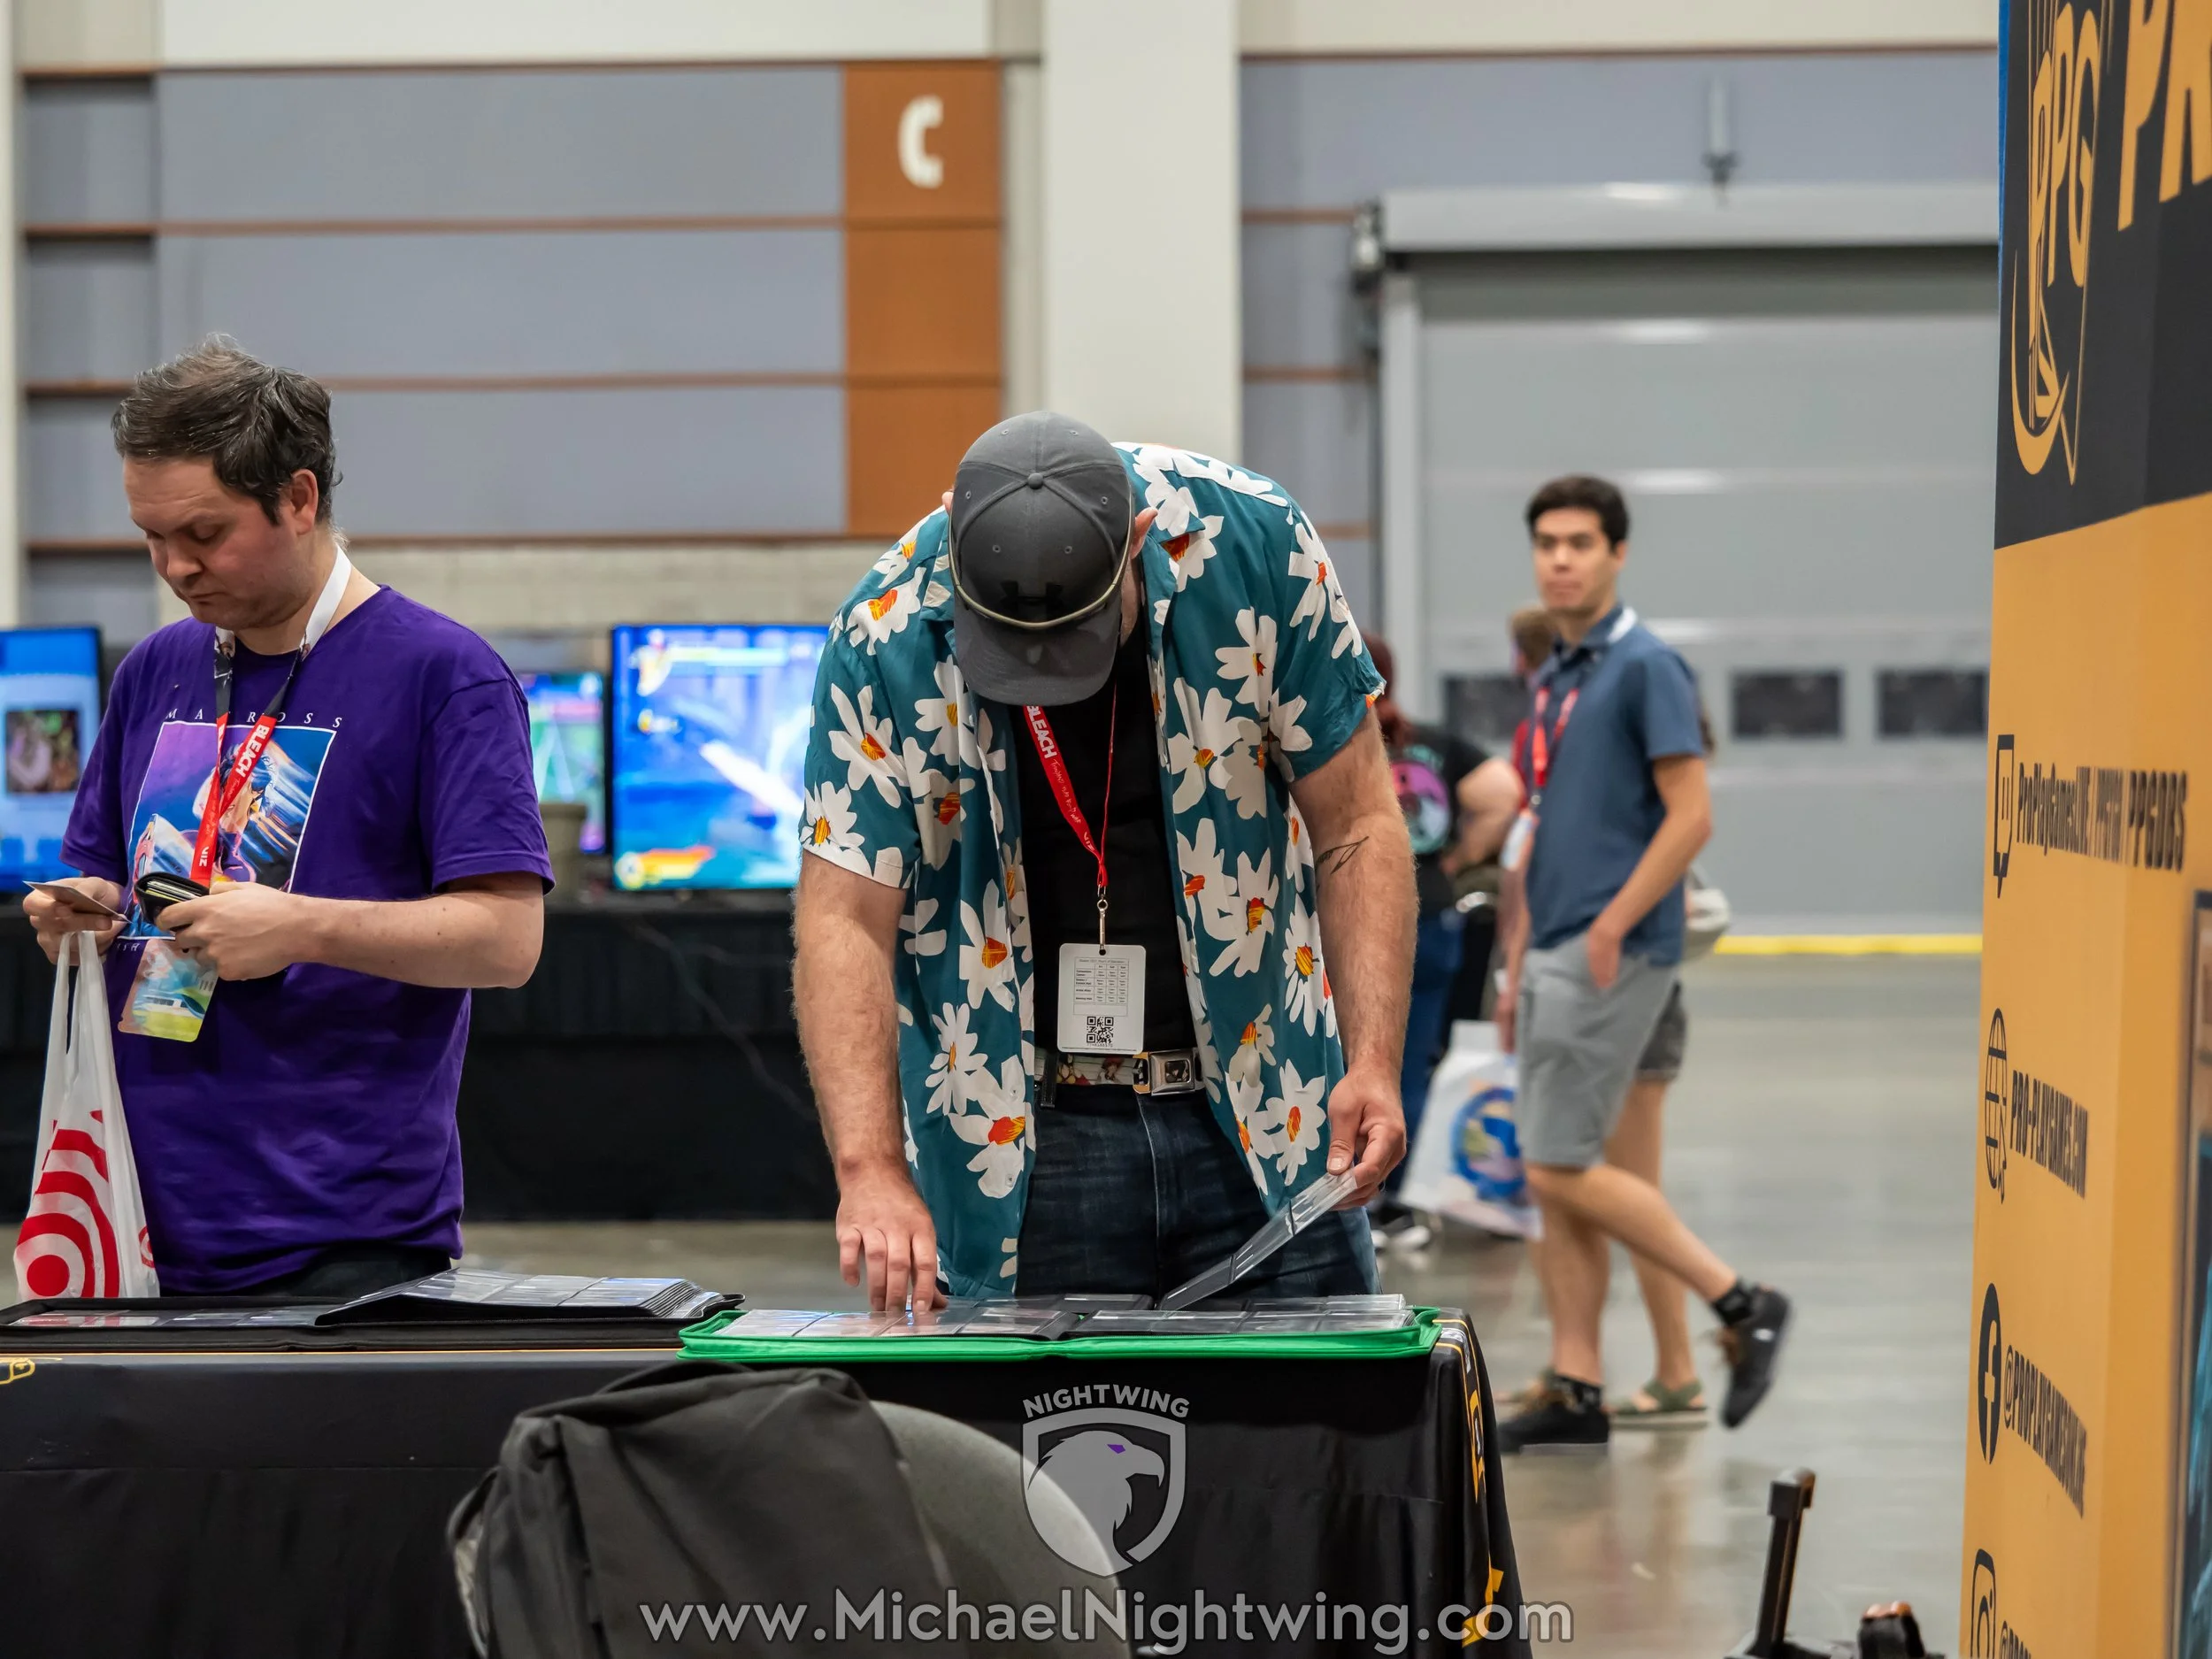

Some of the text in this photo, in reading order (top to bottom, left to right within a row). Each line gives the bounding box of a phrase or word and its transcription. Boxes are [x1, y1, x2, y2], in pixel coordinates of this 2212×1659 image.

[898, 93, 944, 188] C
[165, 708, 342, 729] MAROSS
[235, 724, 270, 778] BLEACH
[199, 846, 210, 867] VIZ
